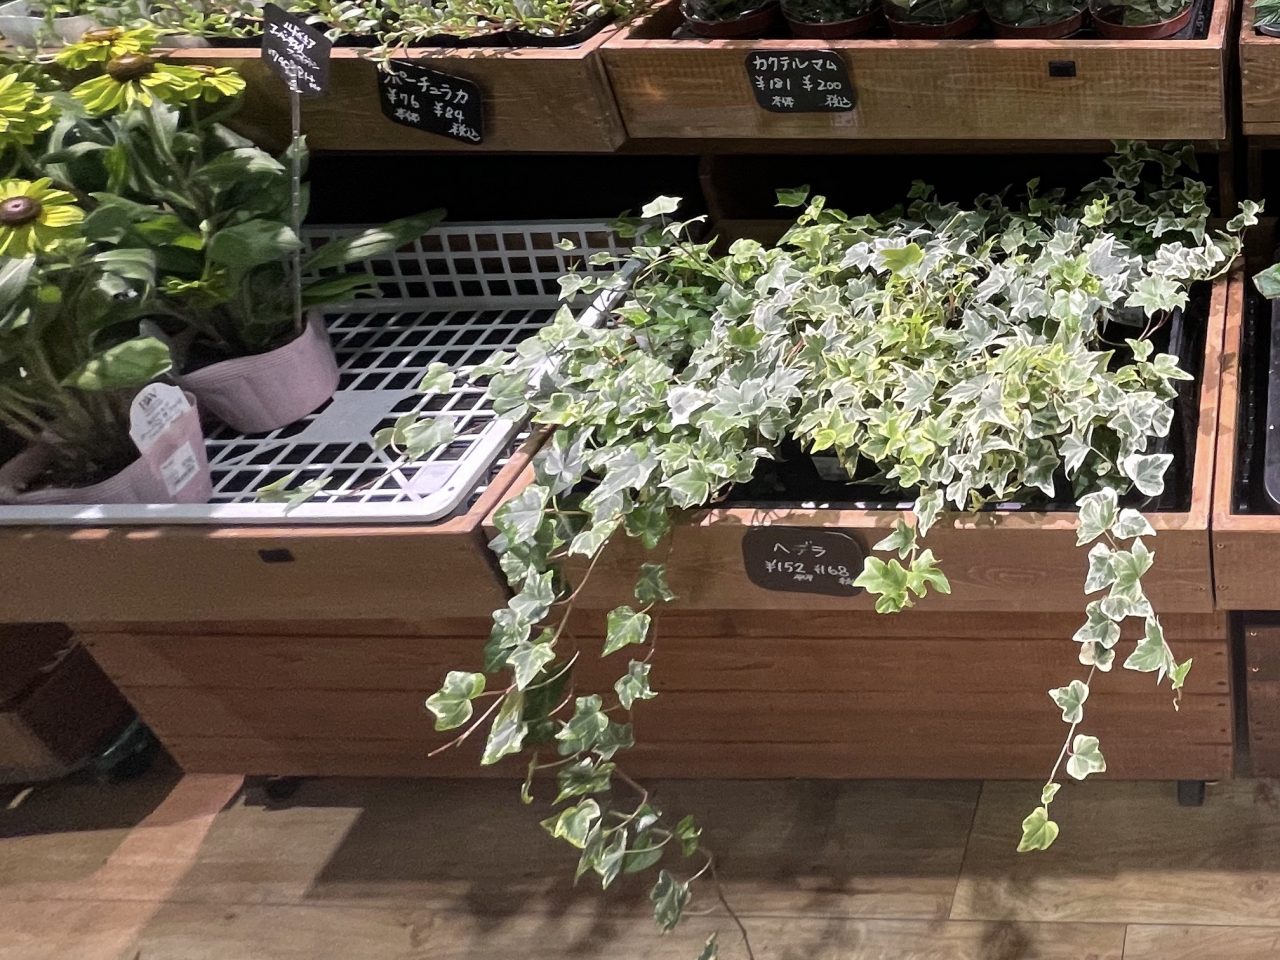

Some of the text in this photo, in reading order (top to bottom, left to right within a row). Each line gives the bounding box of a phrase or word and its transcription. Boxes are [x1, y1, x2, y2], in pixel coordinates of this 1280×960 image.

[752, 55, 837, 72] カクテルマム
[384, 70, 470, 105] ポーチュラカ
[755, 74, 842, 92] ¥181 ¥200
[387, 87, 420, 109] ¥76
[773, 540, 827, 558] ヘデラ
[765, 558, 806, 573] ¥152
